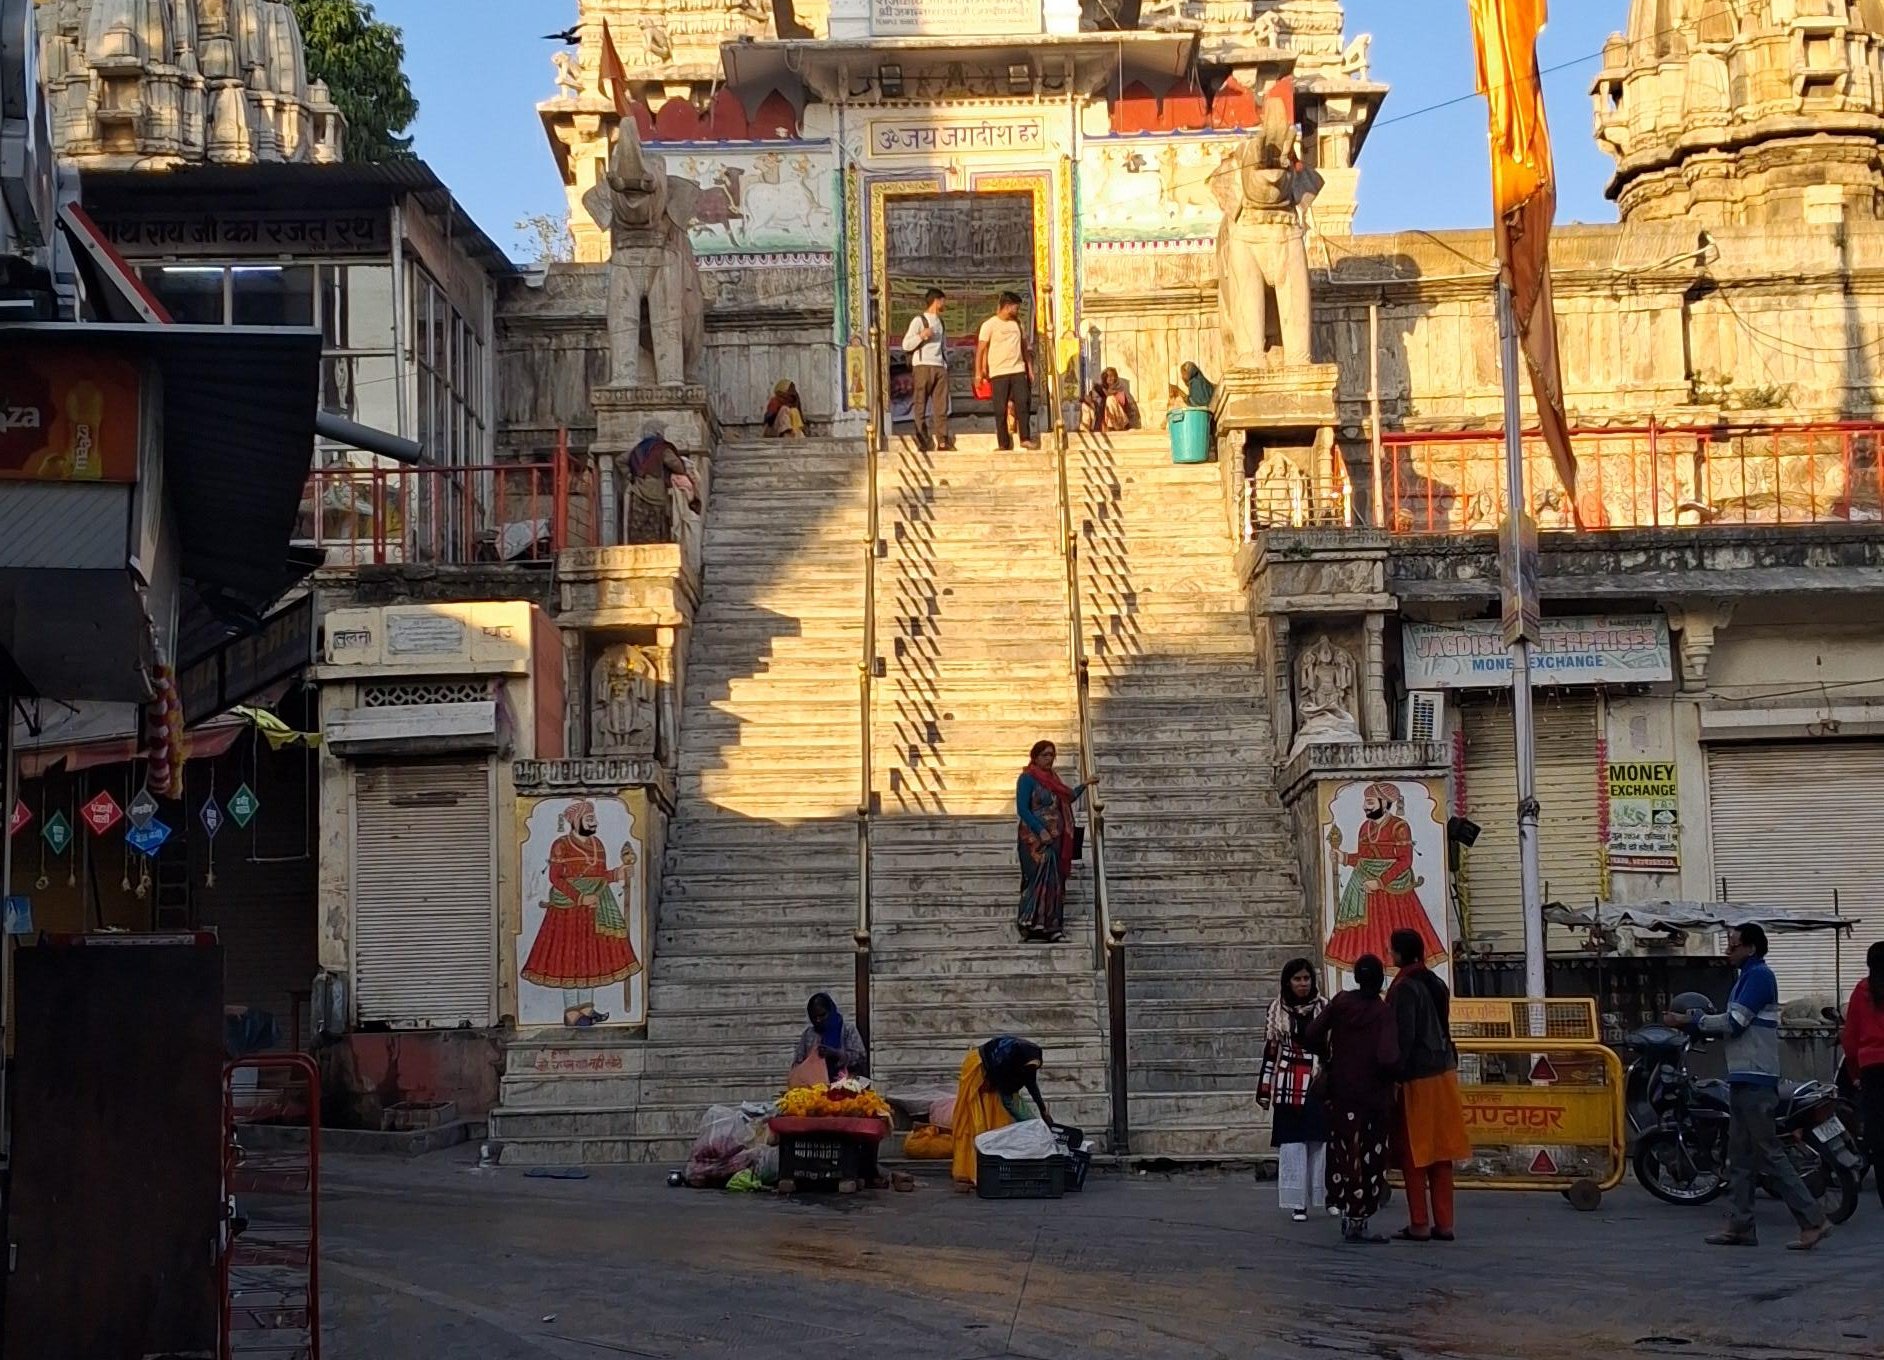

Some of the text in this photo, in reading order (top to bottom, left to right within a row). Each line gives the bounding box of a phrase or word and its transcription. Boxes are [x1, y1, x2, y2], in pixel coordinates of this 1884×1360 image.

[900, 127, 939, 149] जय
[941, 121, 1013, 147] जगदीश
[1018, 119, 1039, 143] हरे
[147, 221, 184, 246] राय
[192, 217, 217, 242] जी
[224, 219, 258, 242] का
[265, 219, 326, 243] रजत
[336, 216, 375, 245] रथ
[1416, 629, 1658, 658] JAGDISH TERPRISES
[1472, 655, 1603, 672] MONE EXCHANGE
[1610, 764, 1674, 781] MONEY
[1611, 784, 1676, 796] EXCHANGE
